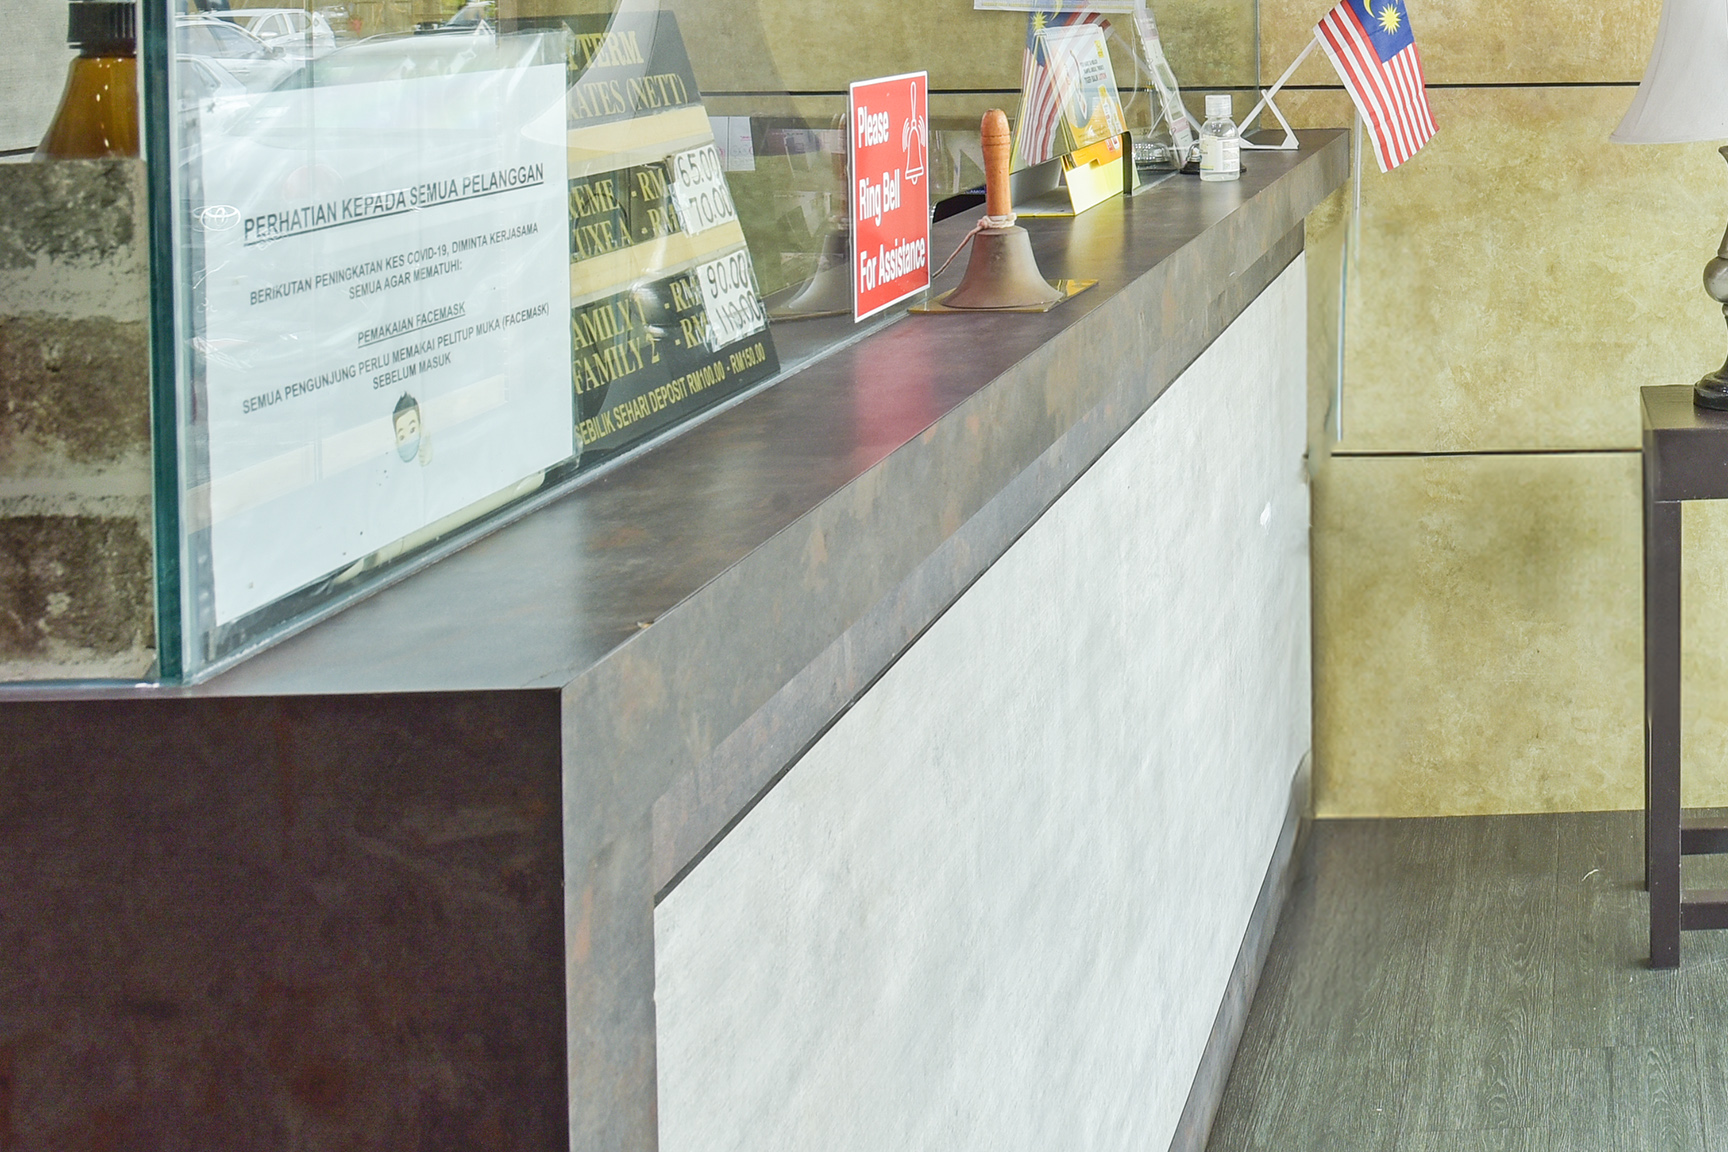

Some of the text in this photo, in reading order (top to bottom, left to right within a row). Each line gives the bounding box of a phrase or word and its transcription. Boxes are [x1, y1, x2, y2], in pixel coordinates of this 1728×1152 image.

[576, 31, 644, 69] TERM
[626, 73, 688, 112] (NETT)
[858, 106, 890, 149] Please
[244, 163, 545, 242] PERHATIAN KEPADA SEMUA PELANGGAN
[637, 147, 718, 202] RM 65.00
[859, 168, 901, 227] Ring Bell
[689, 184, 735, 227] 70.00
[250, 222, 539, 305] BERIKUTAN PENINGKATAN KES COVID-19, DIMINTA KERJASAMA
[348, 260, 463, 300] SEMUA AGAR MEMATUHI:
[860, 236, 926, 294] For Assistance
[358, 302, 466, 345] PEMAKAIAN FACEMASK
[573, 298, 634, 352] AMILY
[706, 252, 750, 299] 90.00
[242, 302, 549, 414] SEMUA PENGUNJUNG PERLU MEMAKAI PELITUP MUKA (FACEMASK)
[372, 352, 452, 390] SEBELUM MASUK
[573, 337, 645, 396] FAMILY
[645, 333, 660, 364] 2
[612, 394, 650, 430] SEHARI
[648, 375, 687, 414] DEPOSIT
[686, 360, 726, 395] RM100.00
